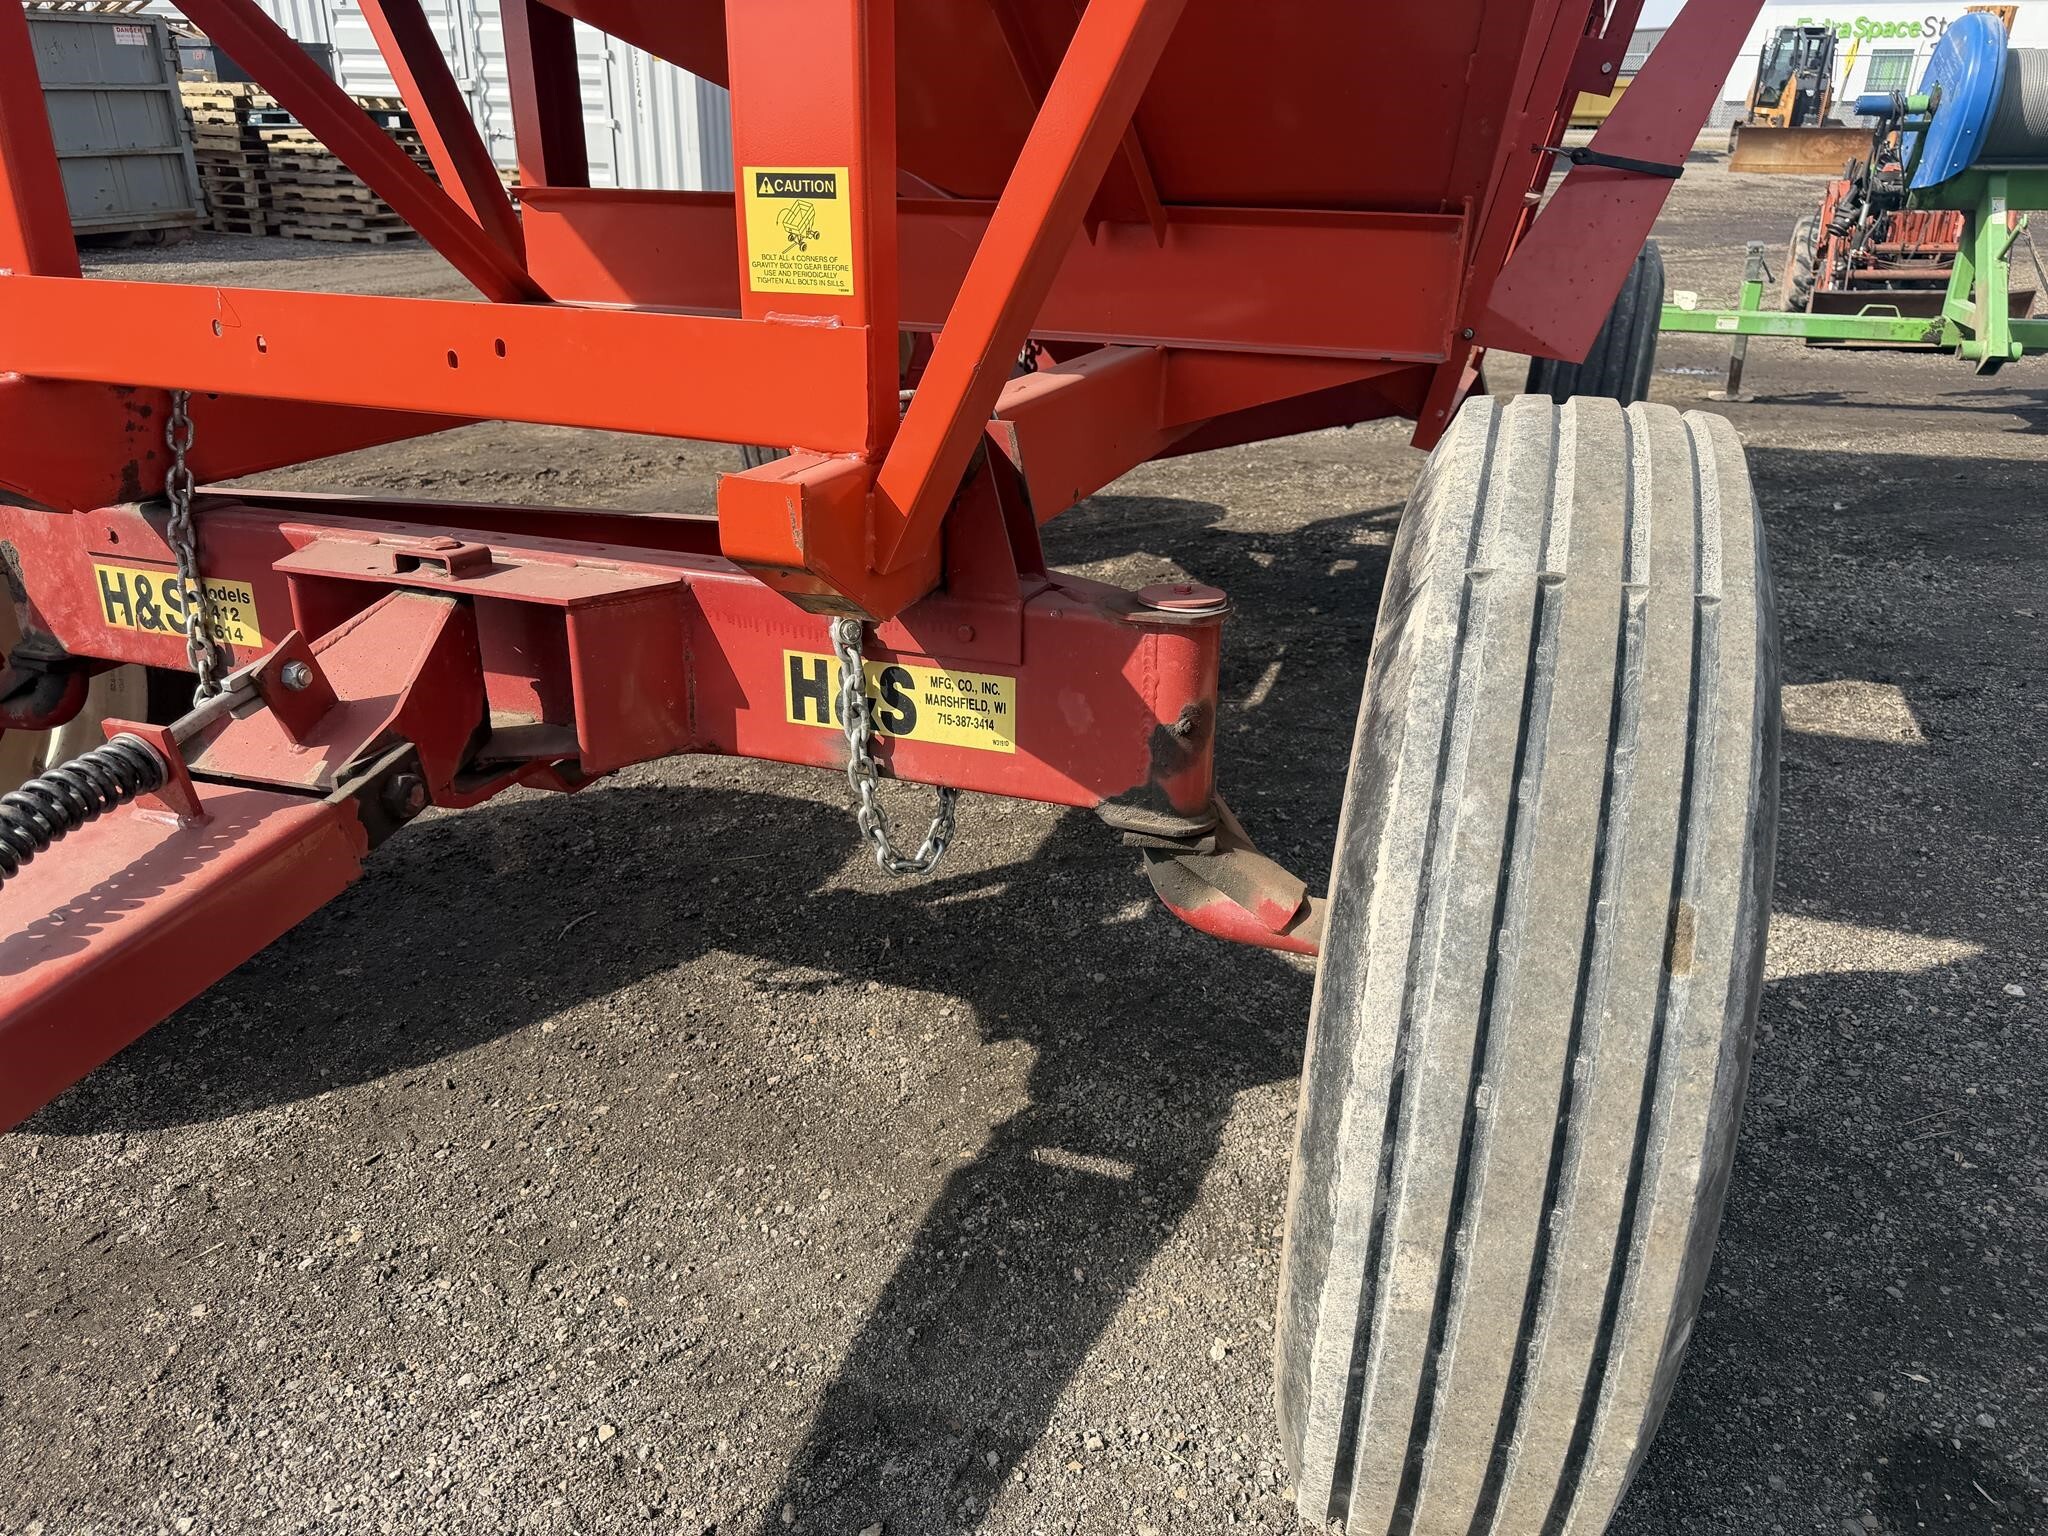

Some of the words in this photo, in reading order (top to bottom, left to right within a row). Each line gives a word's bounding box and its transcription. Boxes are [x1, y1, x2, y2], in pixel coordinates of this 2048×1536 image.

[774, 179, 834, 193] CAUTION
[796, 255, 828, 263] CORNERS
[803, 263, 822, 271] GEAR
[823, 264, 849, 272] BEFORE
[756, 276, 784, 284] TIGHTEN
[797, 278, 818, 286] BOLTS
[763, 269, 776, 277] USE
[792, 270, 838, 279] PERIODICALLY
[98, 570, 196, 635] H&S
[211, 605, 241, 622] 412
[214, 624, 244, 641] 614
[958, 679, 978, 695] CO.,
[981, 682, 1001, 696] INC.
[925, 693, 990, 715] MARSHFIELD,
[994, 701, 1007, 715] WI
[937, 713, 995, 731] 715-387-3414
